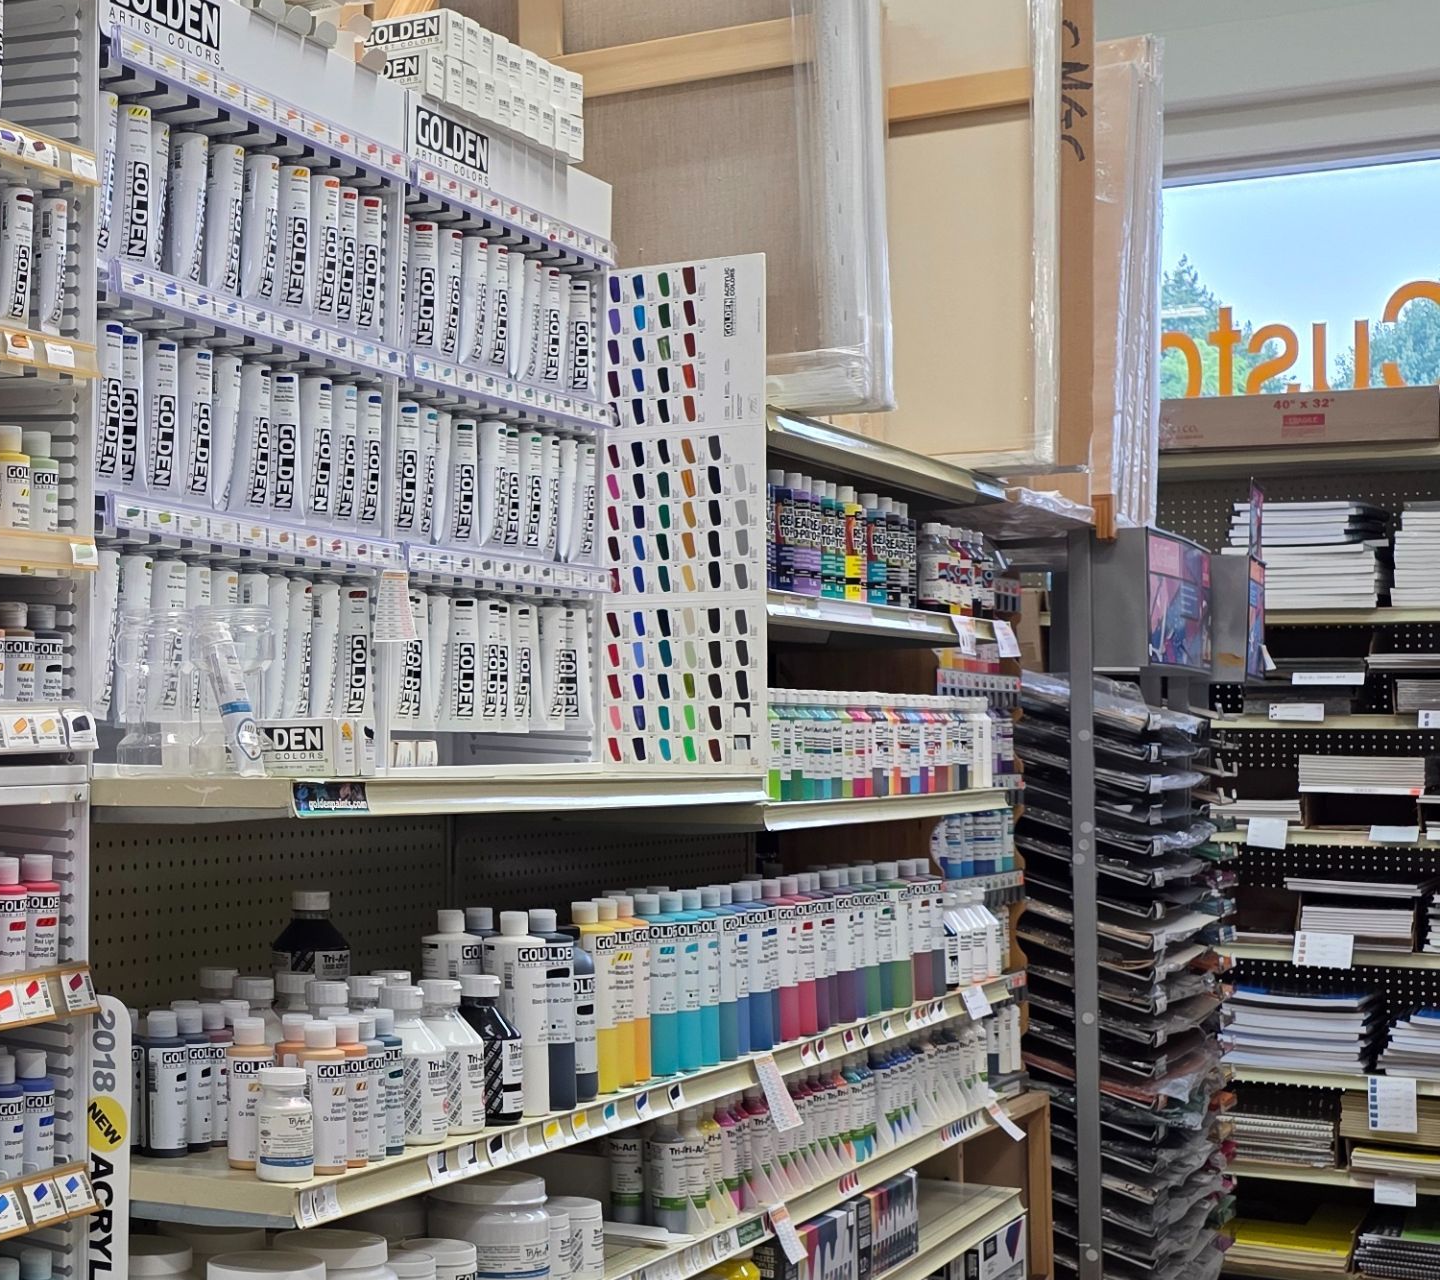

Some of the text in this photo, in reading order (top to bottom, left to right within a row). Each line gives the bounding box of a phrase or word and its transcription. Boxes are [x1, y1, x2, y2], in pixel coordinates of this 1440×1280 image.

[109, 7, 221, 66] ARTIST COLORS
[380, 55, 419, 80] DEN
[401, 36, 440, 51] COLORS
[416, 106, 489, 173] GOLDEN
[416, 148, 489, 187] ARTIST COLORS
[127, 162, 149, 258] GOLDEN
[10, 244, 30, 318] GOLDEN
[416, 267, 435, 347] GOLDEN
[1273, 400, 1295, 410] 40"
[1313, 399, 1335, 409] 32"
[276, 424, 297, 508] GOLDEN
[397, 450, 417, 529] GOLDEN
[455, 464, 475, 540] GOLDEN
[348, 634, 367, 714] GOLDEN
[457, 643, 475, 717] GOLDEN
[272, 727, 323, 751] DEN
[274, 752, 324, 760] COLORS
[309, 799, 368, 811] goldenpaints.com
[91, 1008, 116, 1093] 2018
[89, 1101, 122, 1147] NEW
